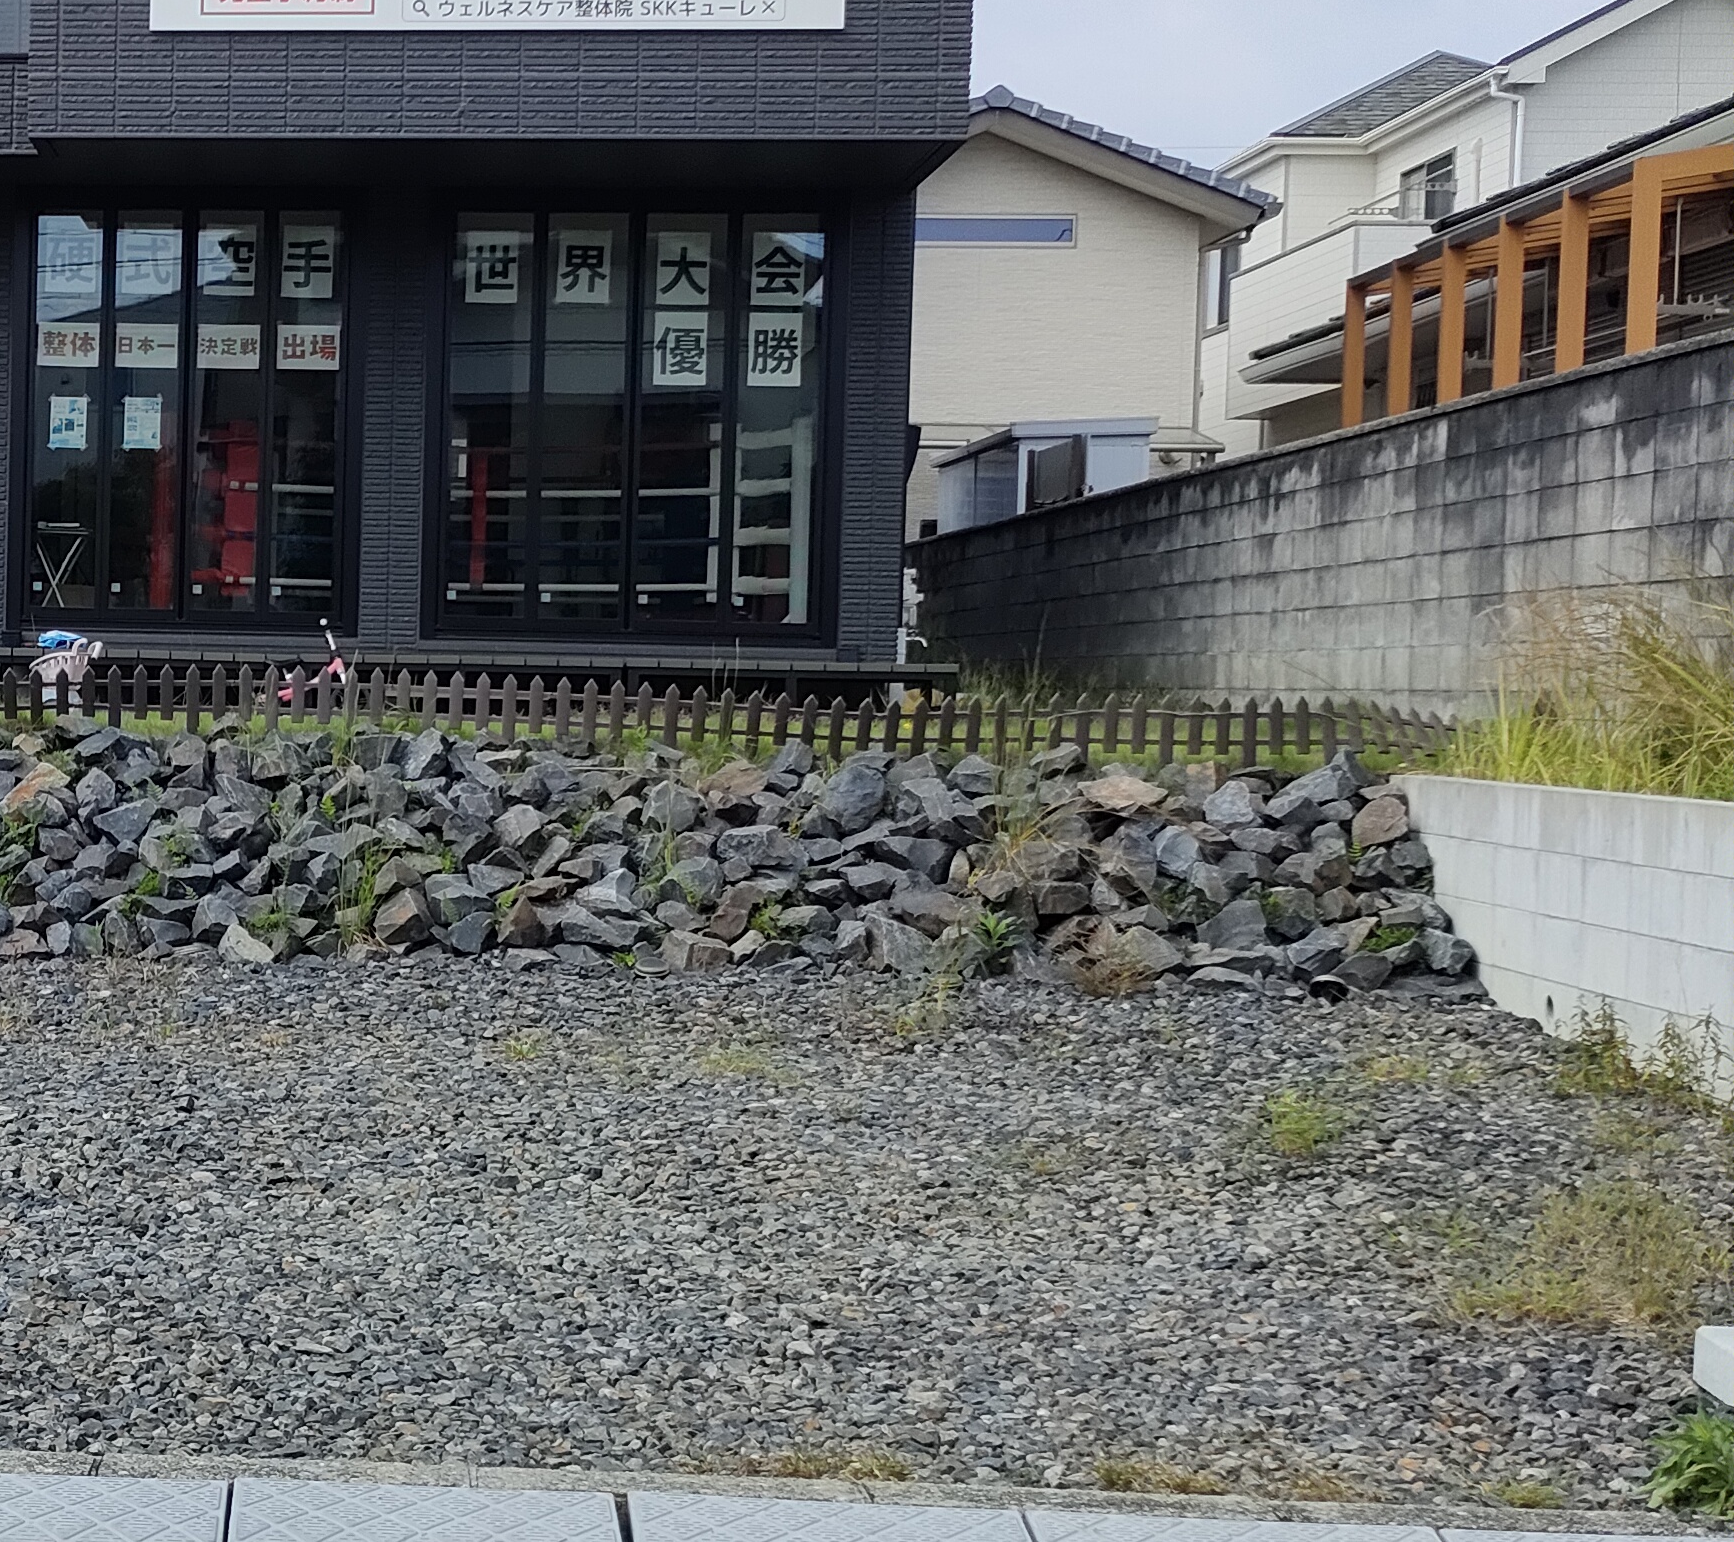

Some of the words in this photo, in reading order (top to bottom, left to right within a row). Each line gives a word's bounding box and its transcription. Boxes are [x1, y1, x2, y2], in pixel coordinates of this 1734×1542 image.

[42, 330, 96, 357] 整体
[118, 335, 176, 355] 日本一
[199, 336, 258, 357] 決定戦
[281, 333, 338, 361] 出場
